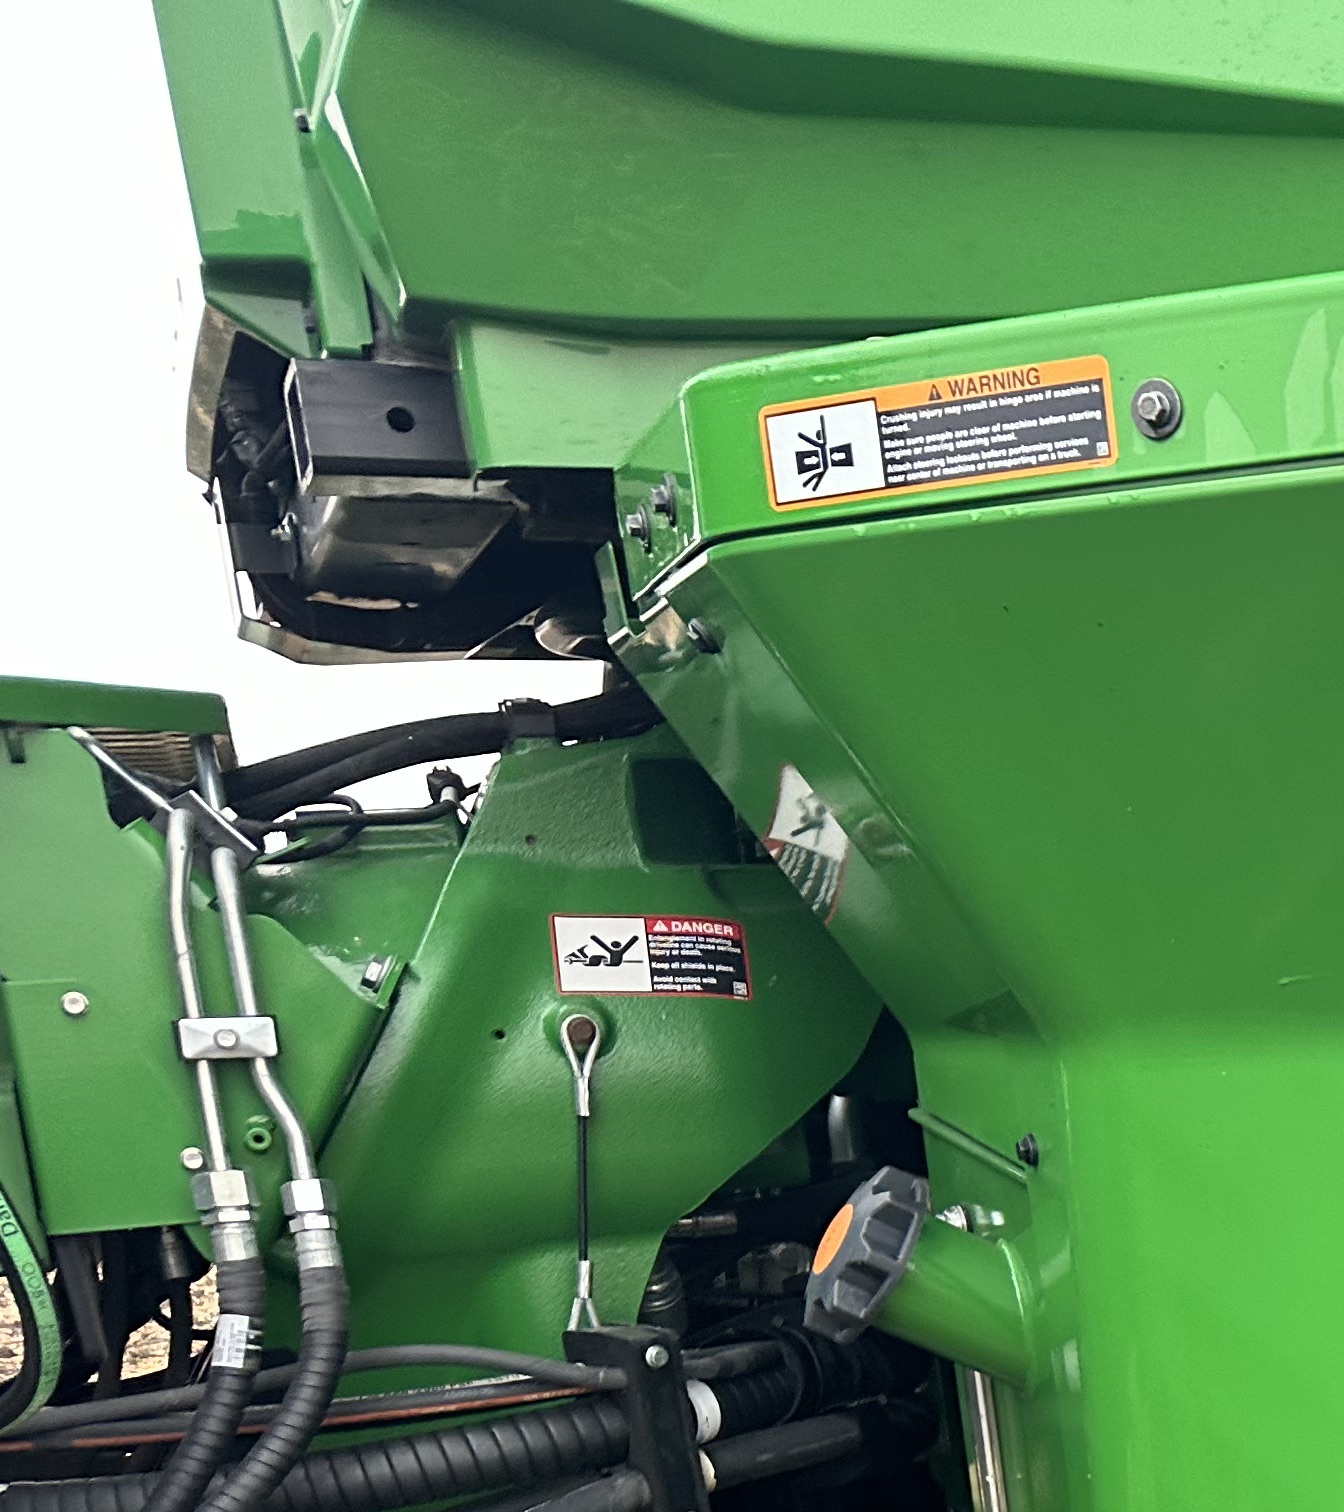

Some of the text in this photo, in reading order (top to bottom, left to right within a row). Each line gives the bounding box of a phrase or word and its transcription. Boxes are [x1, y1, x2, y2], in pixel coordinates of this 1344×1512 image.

[947, 367, 1041, 397] WARNING
[881, 412, 918, 424] Crushing
[919, 409, 942, 419] injury
[944, 406, 961, 415] may
[963, 400, 987, 411] result
[989, 399, 997, 407] in
[999, 396, 1023, 406] hinge
[1025, 393, 1043, 402] area
[1054, 386, 1089, 398] machine
[1091, 383, 1099, 392] is
[884, 439, 905, 448] Make
[906, 436, 924, 445] sure
[925, 431, 953, 443] people
[970, 427, 990, 435] clear
[991, 423, 1000, 432] of
[1002, 419, 1037, 431] machine
[1039, 415, 1066, 425] before
[1068, 410, 1101, 421] starting
[885, 448, 912, 459] engine
[924, 442, 954, 452] moving
[956, 437, 989, 448] steering
[887, 462, 912, 473] Attach
[913, 458, 945, 469] steering
[981, 449, 1007, 459] before
[1008, 442, 1053, 456] performing
[942, 464, 975, 475] machine
[671, 921, 733, 936] DANGER
